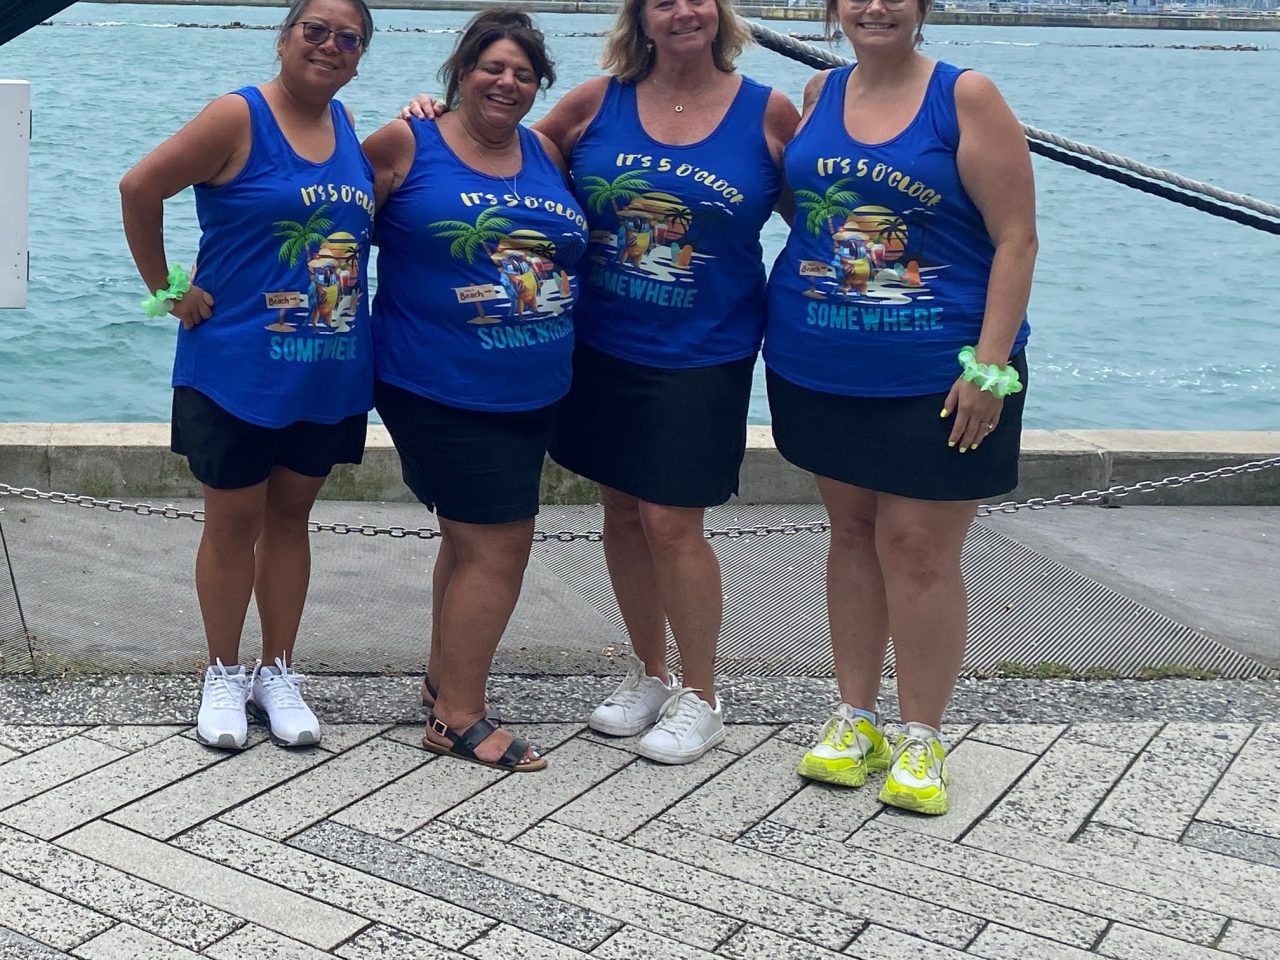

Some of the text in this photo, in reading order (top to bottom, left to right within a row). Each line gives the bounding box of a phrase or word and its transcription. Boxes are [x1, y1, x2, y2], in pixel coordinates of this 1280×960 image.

[616, 153, 744, 204] IT'S 5 O'CLOCK
[817, 157, 942, 206] IT'S 5 O'CLOCK
[300, 184, 326, 206] IT'S
[328, 184, 338, 202] 5
[460, 192, 498, 206] IT'S
[503, 194, 520, 206] 5
[460, 290, 484, 300] Beach
[596, 268, 698, 308] MEWHERE
[268, 296, 290, 306] Beach
[807, 302, 944, 331] SOMEWHERE
